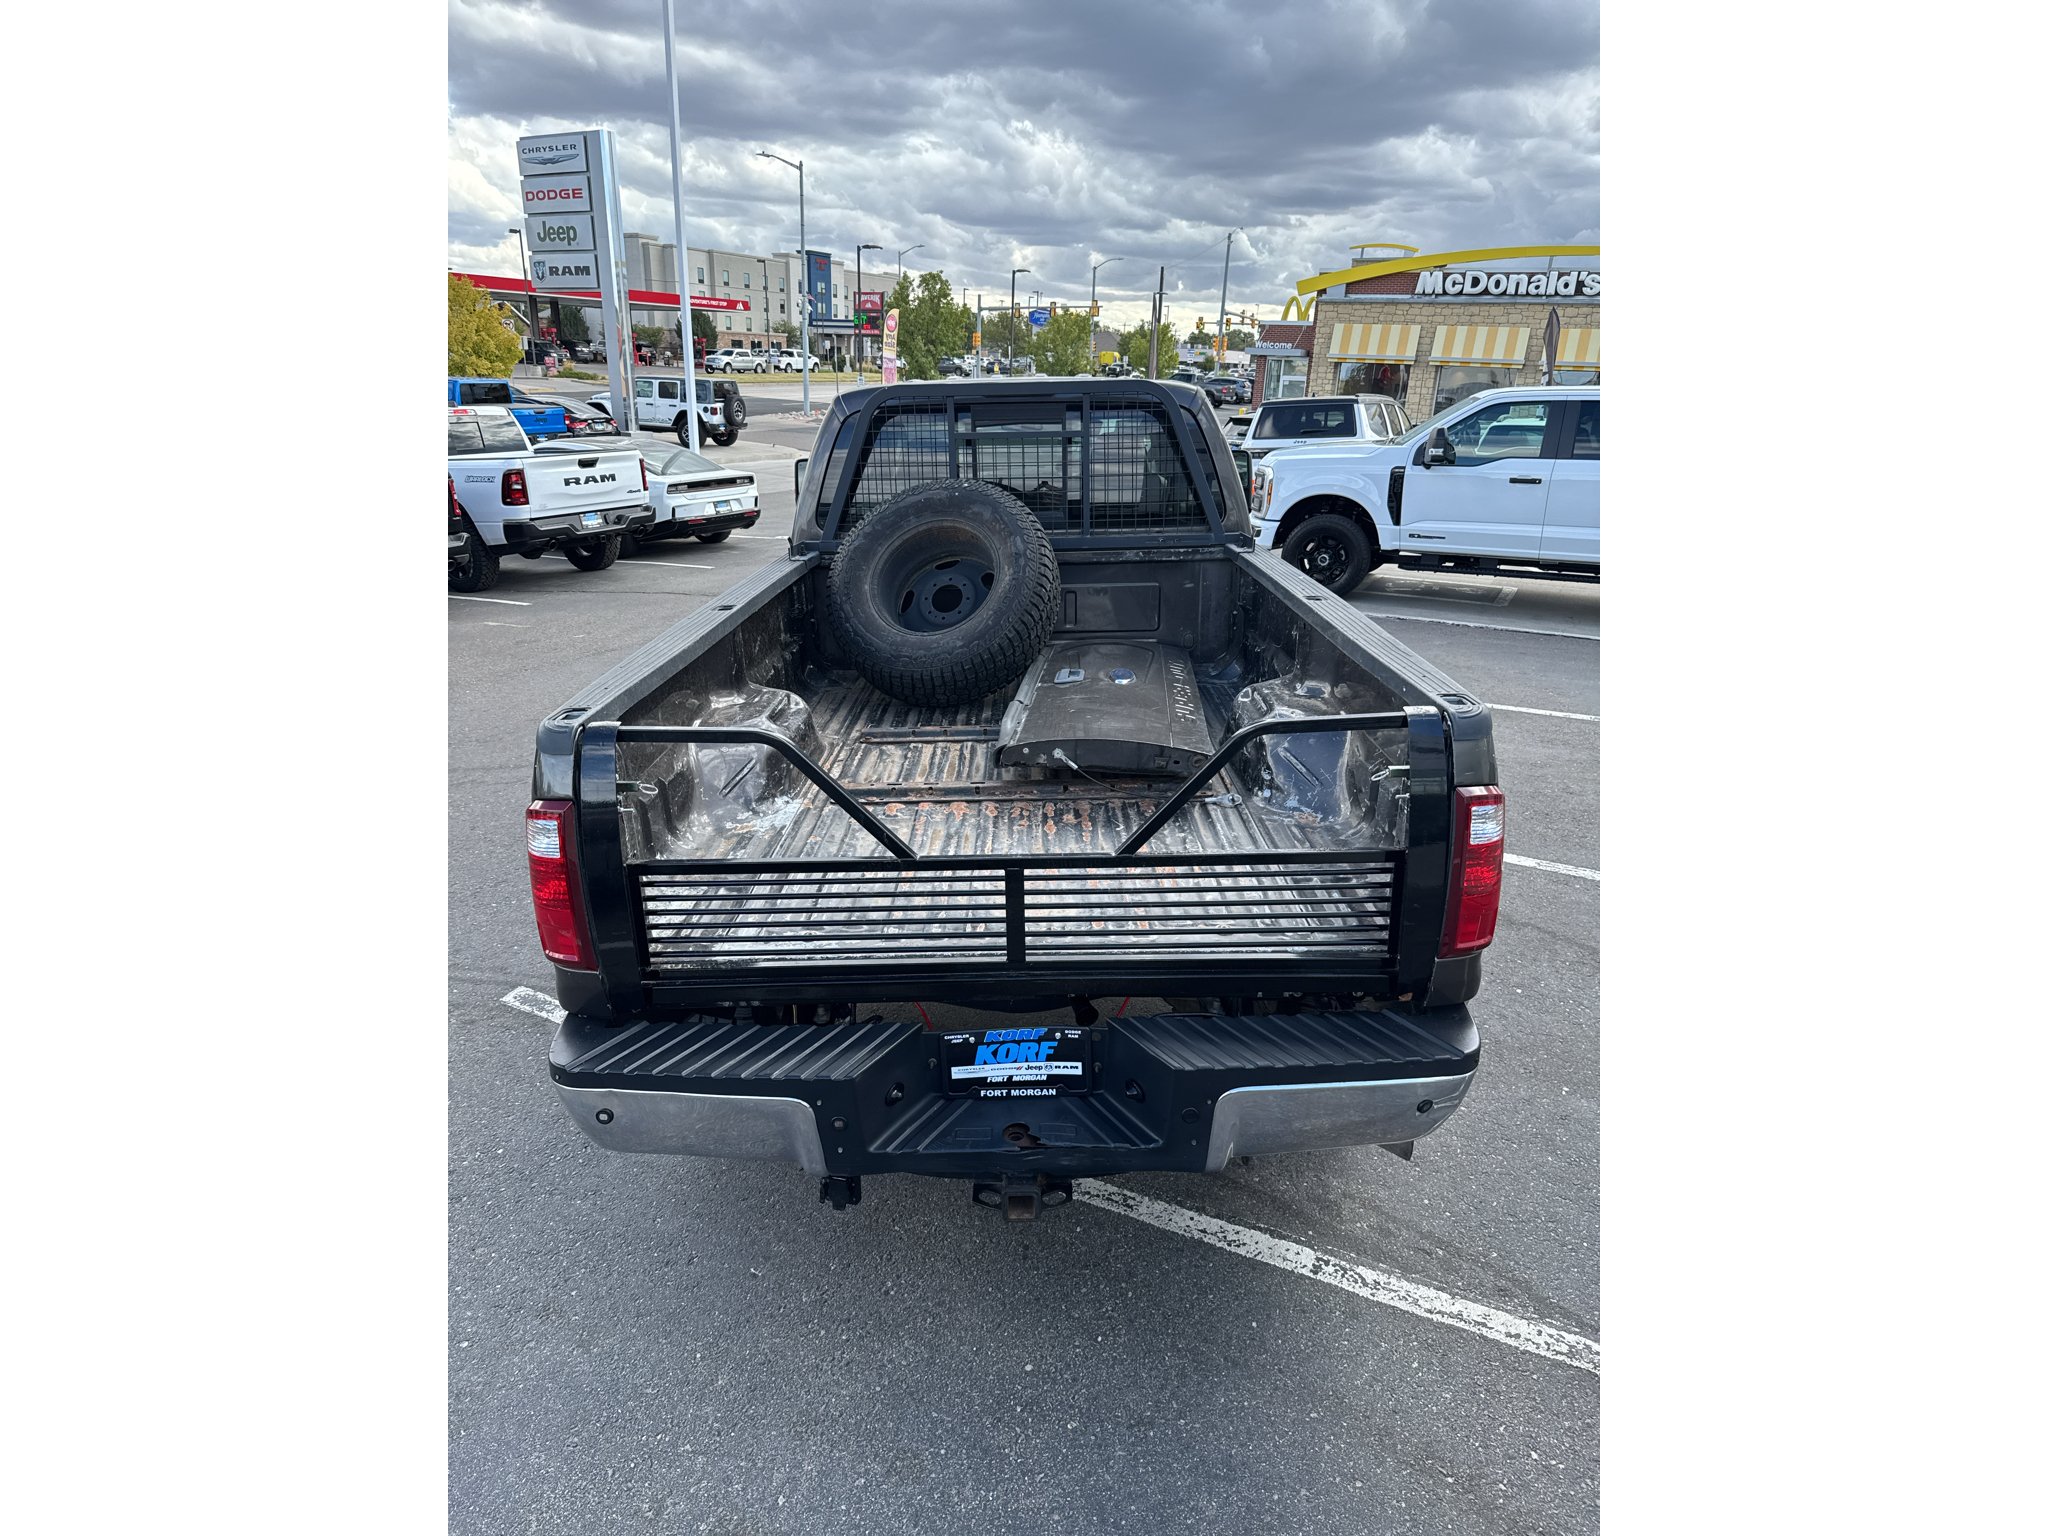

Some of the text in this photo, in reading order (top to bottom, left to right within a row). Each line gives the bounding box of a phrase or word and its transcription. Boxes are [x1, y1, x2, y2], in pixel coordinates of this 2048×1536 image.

[521, 143, 577, 155] CHRYSLER
[525, 188, 583, 202] DODGE
[536, 220, 578, 246] Jeep
[548, 265, 591, 277] RAM
[1414, 270, 1600, 296] McDonald's
[1255, 340, 1293, 350] Welcome
[563, 473, 617, 487] RAM
[984, 1028, 1048, 1042] KORF
[974, 1041, 1059, 1066] KORF
[1024, 1064, 1043, 1072] Jeep
[986, 1074, 1048, 1083] FORT MORGAN
[980, 1088, 1057, 1097] FORT MORGAN
